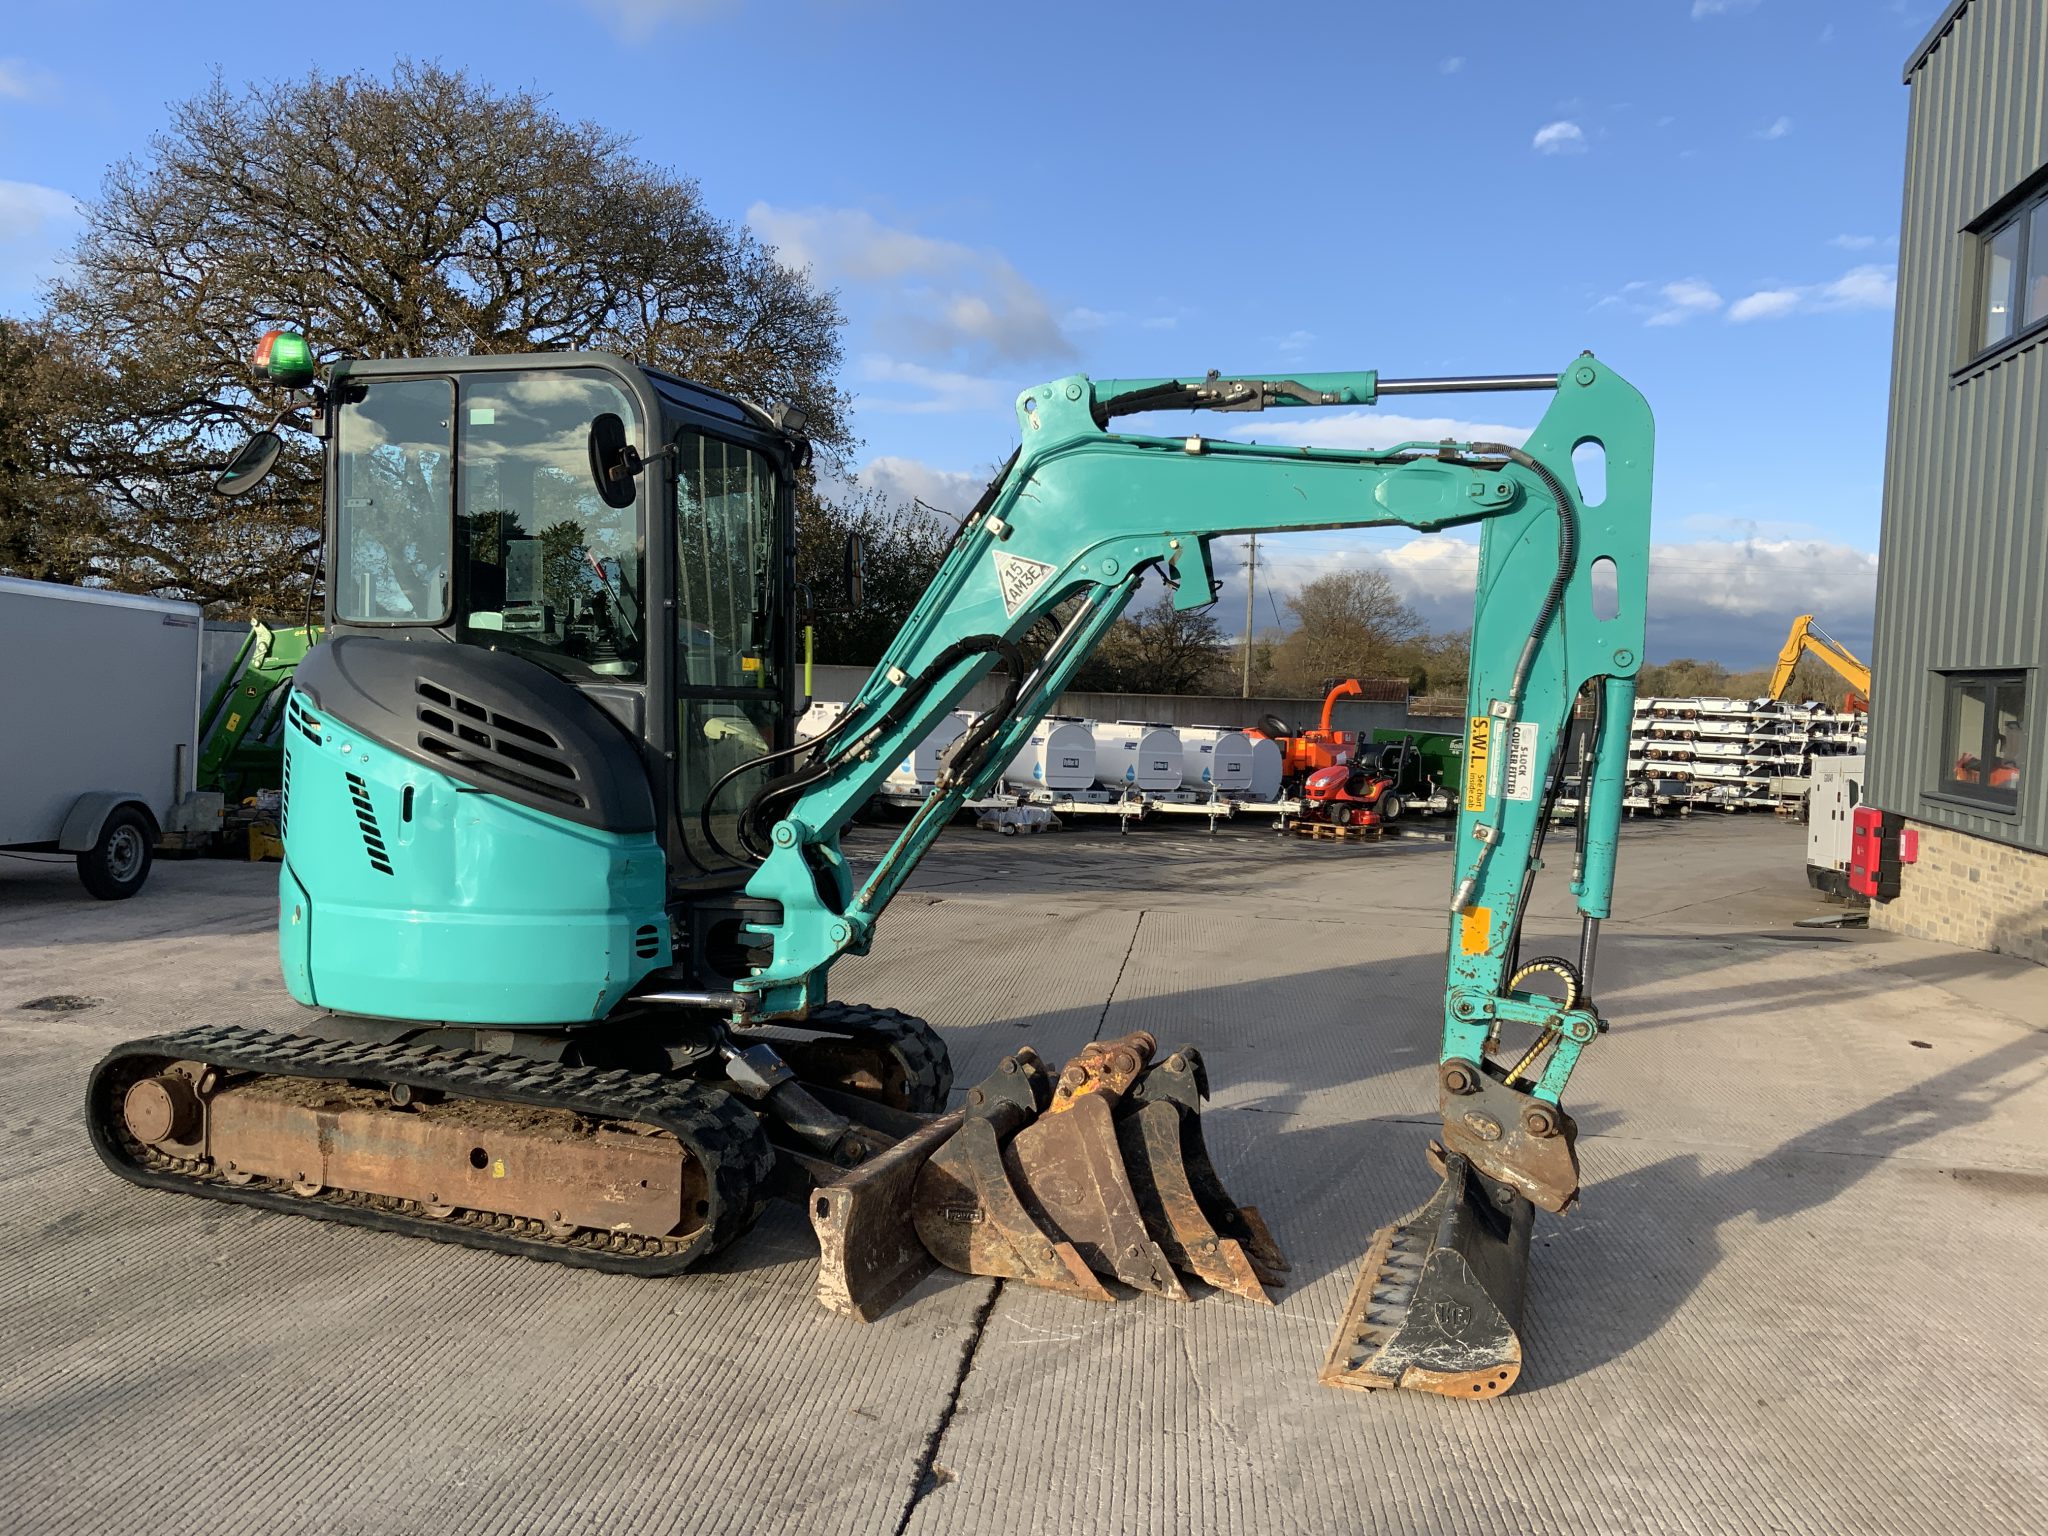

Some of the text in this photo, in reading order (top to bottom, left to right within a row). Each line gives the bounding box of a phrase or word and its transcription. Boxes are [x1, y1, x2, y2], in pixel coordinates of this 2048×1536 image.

[1005, 562, 1023, 583] 15
[1470, 719, 1488, 769] S.W.L.
[1507, 726, 1521, 795] COUPLER FITTED
